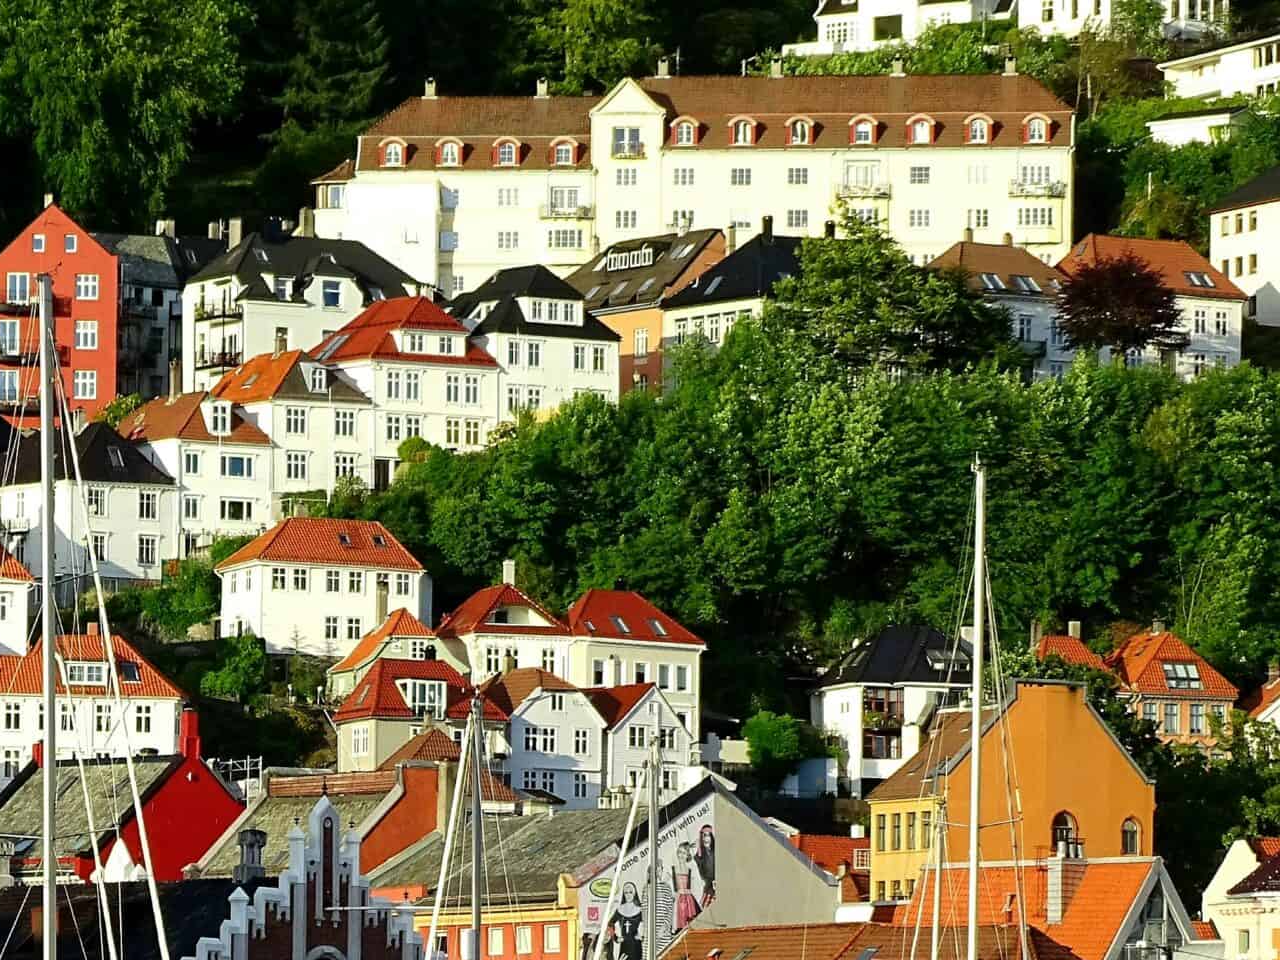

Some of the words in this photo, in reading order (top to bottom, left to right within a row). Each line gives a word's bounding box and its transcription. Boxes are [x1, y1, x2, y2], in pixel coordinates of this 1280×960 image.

[656, 828, 677, 848] party
[677, 815, 696, 831] with
[696, 802, 710, 818] us!
